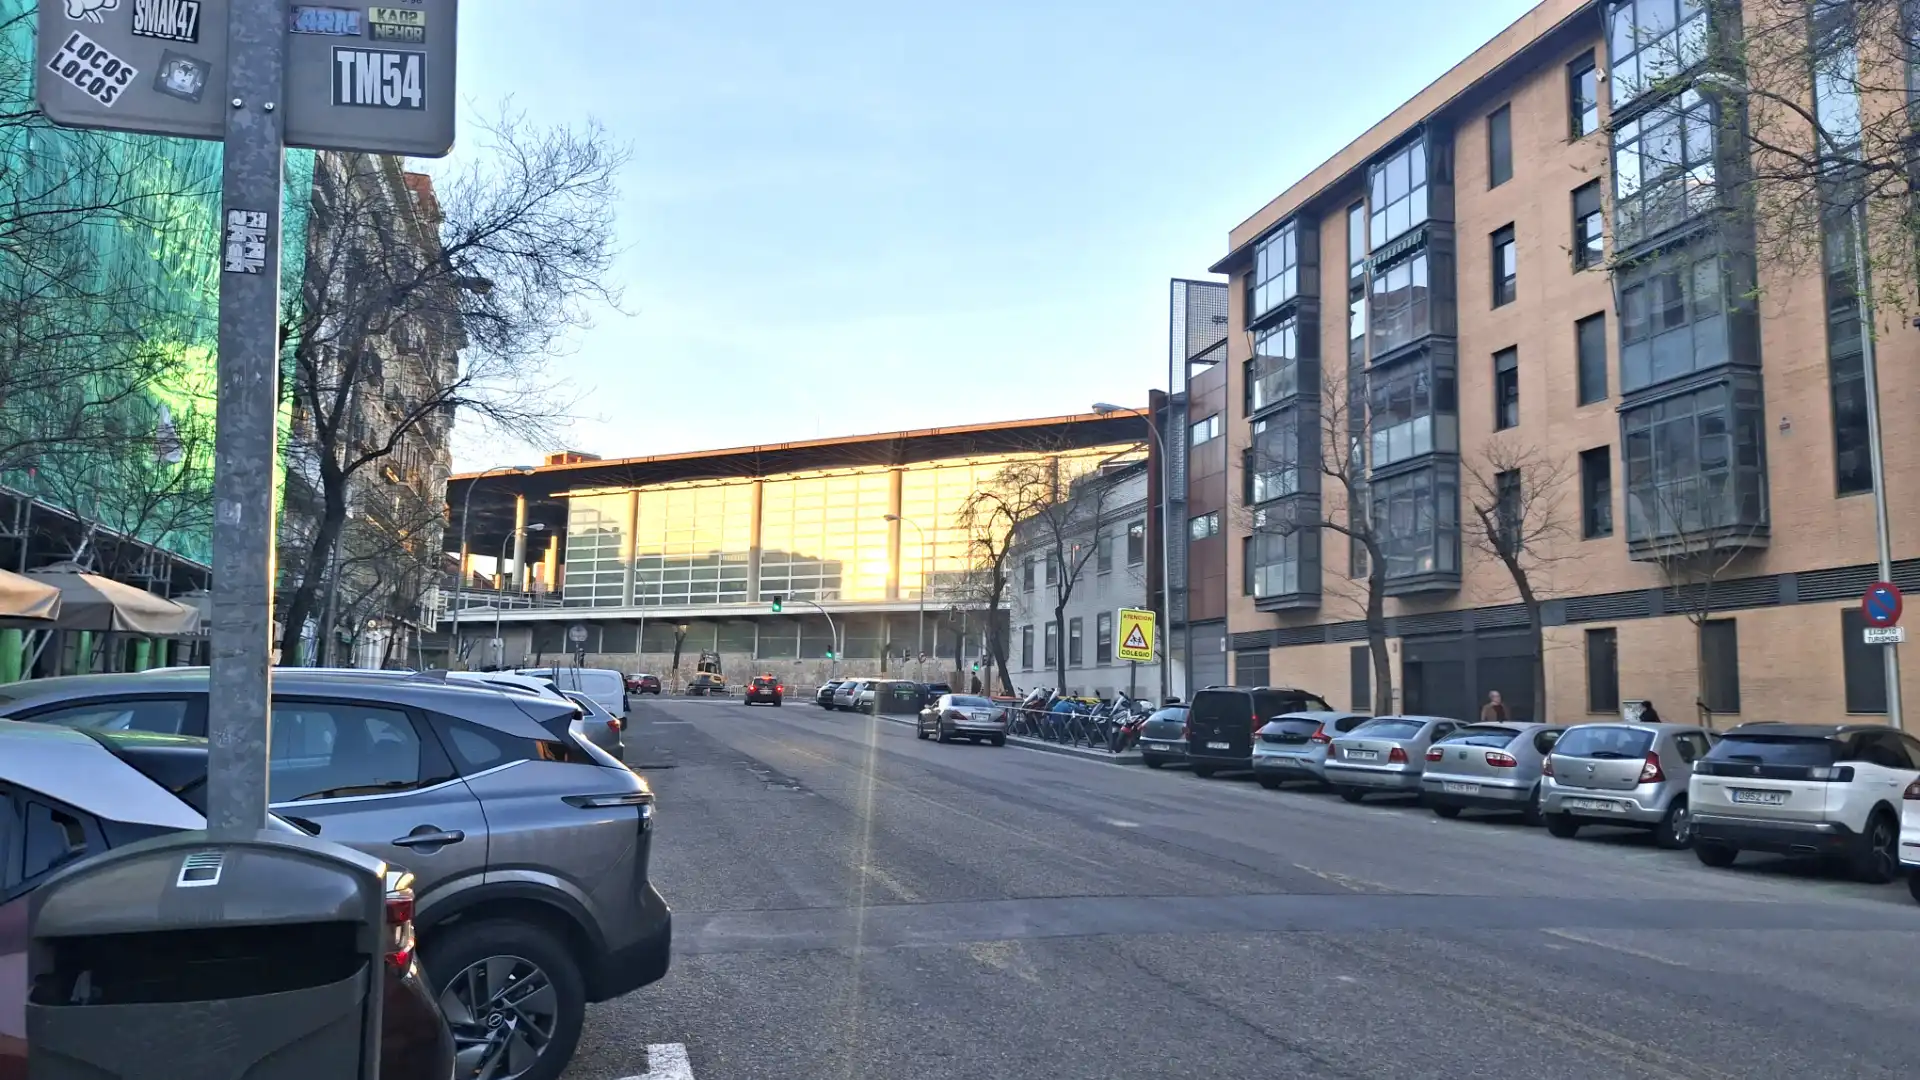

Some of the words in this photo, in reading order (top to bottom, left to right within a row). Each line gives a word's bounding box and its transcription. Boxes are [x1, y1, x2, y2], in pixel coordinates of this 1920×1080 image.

[134, 0, 199, 37] SMAK47
[49, 52, 118, 104] LOCOS
[63, 33, 133, 86] LOCOS
[337, 50, 421, 107] TM54
[1121, 649, 1150, 658] COLEGIO
